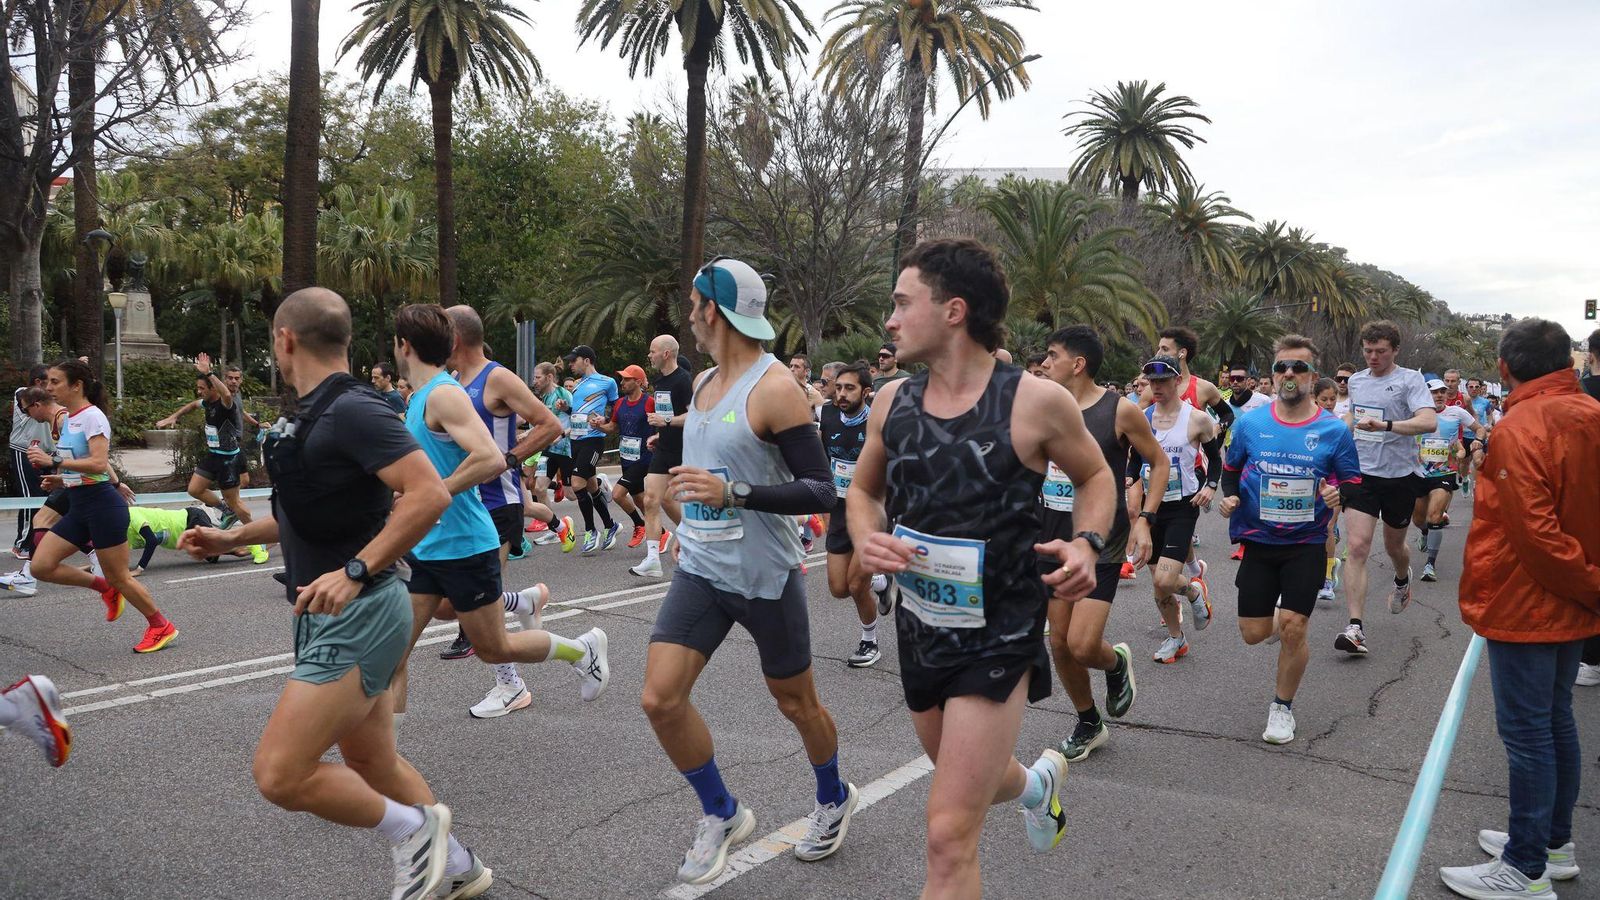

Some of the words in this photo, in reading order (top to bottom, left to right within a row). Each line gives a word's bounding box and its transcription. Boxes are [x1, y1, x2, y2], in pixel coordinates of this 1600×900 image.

[1288, 453, 1314, 461] CORRER
[1426, 448, 1446, 456] 1564
[1277, 498, 1303, 510] 386
[692, 503, 720, 520] 768
[914, 577, 957, 606] 683
